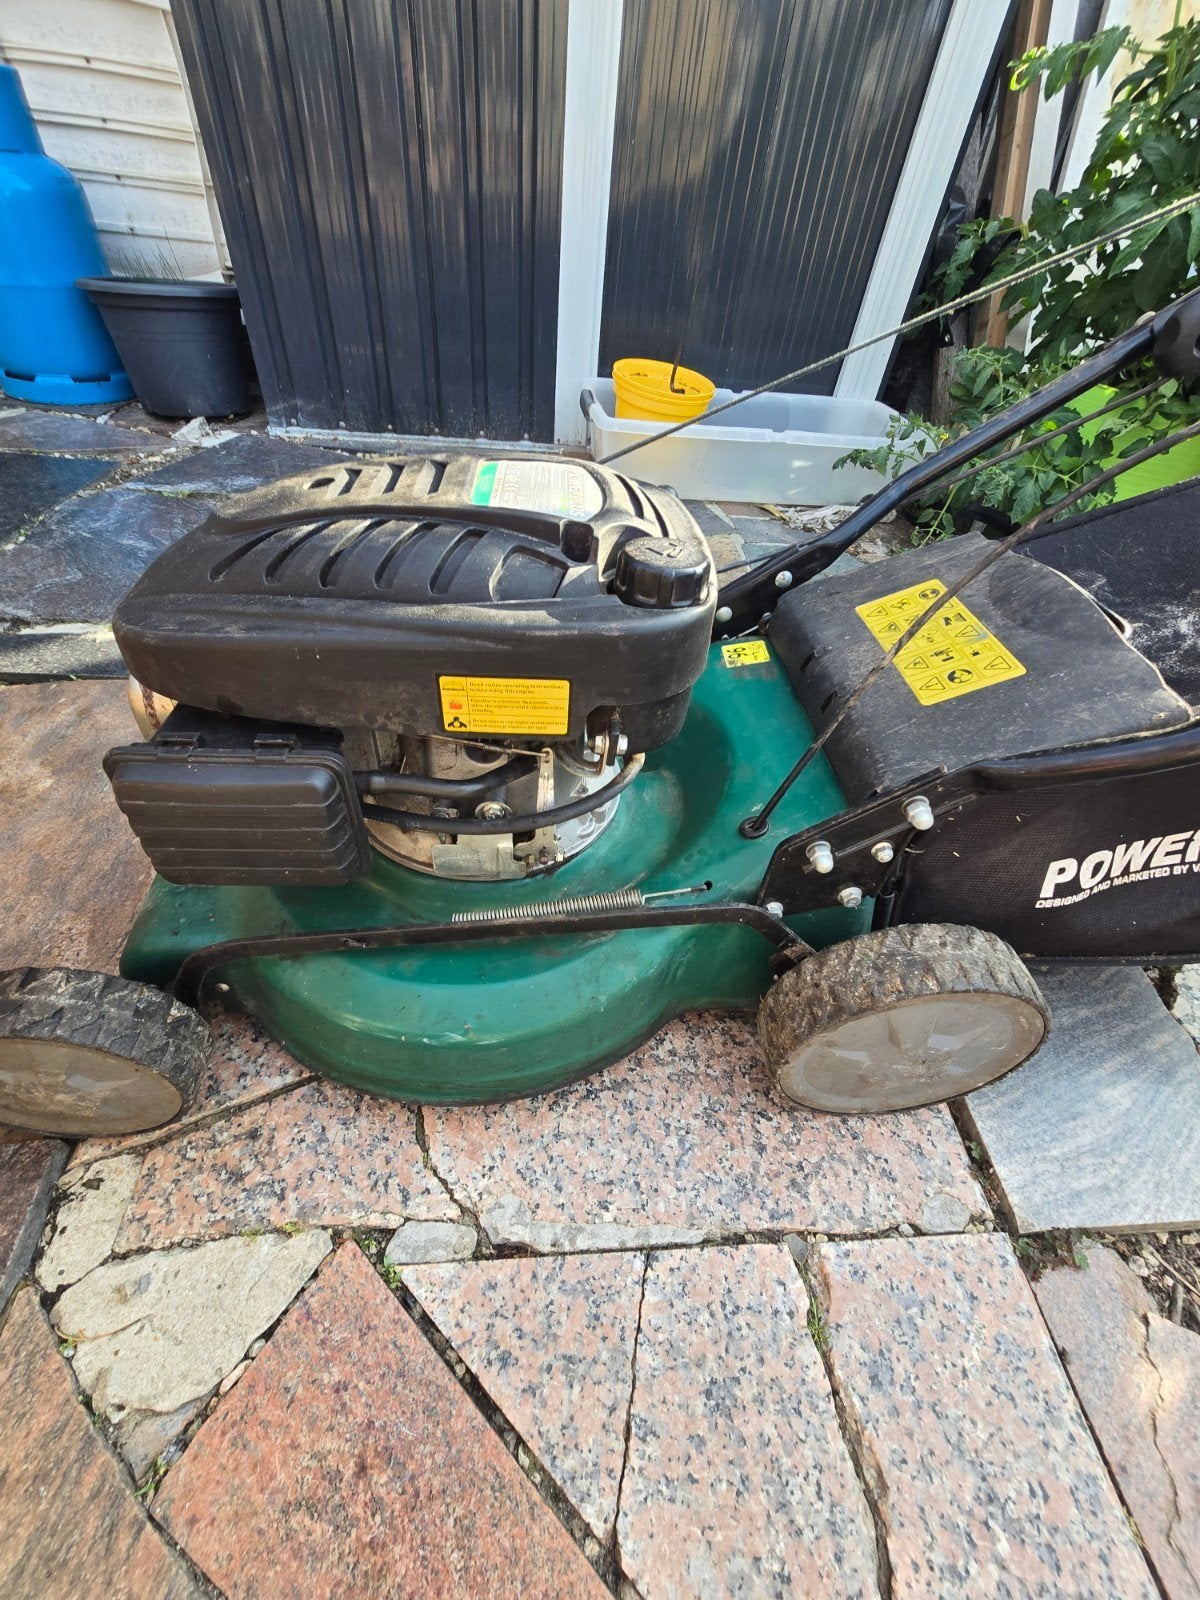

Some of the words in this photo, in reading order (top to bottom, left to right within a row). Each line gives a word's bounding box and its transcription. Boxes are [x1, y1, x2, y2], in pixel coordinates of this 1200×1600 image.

[1035, 889, 1090, 909] DESIGNED
[1091, 880, 1111, 895] AND
[1112, 866, 1170, 886] MARKETED
[1173, 864, 1190, 875] BY
